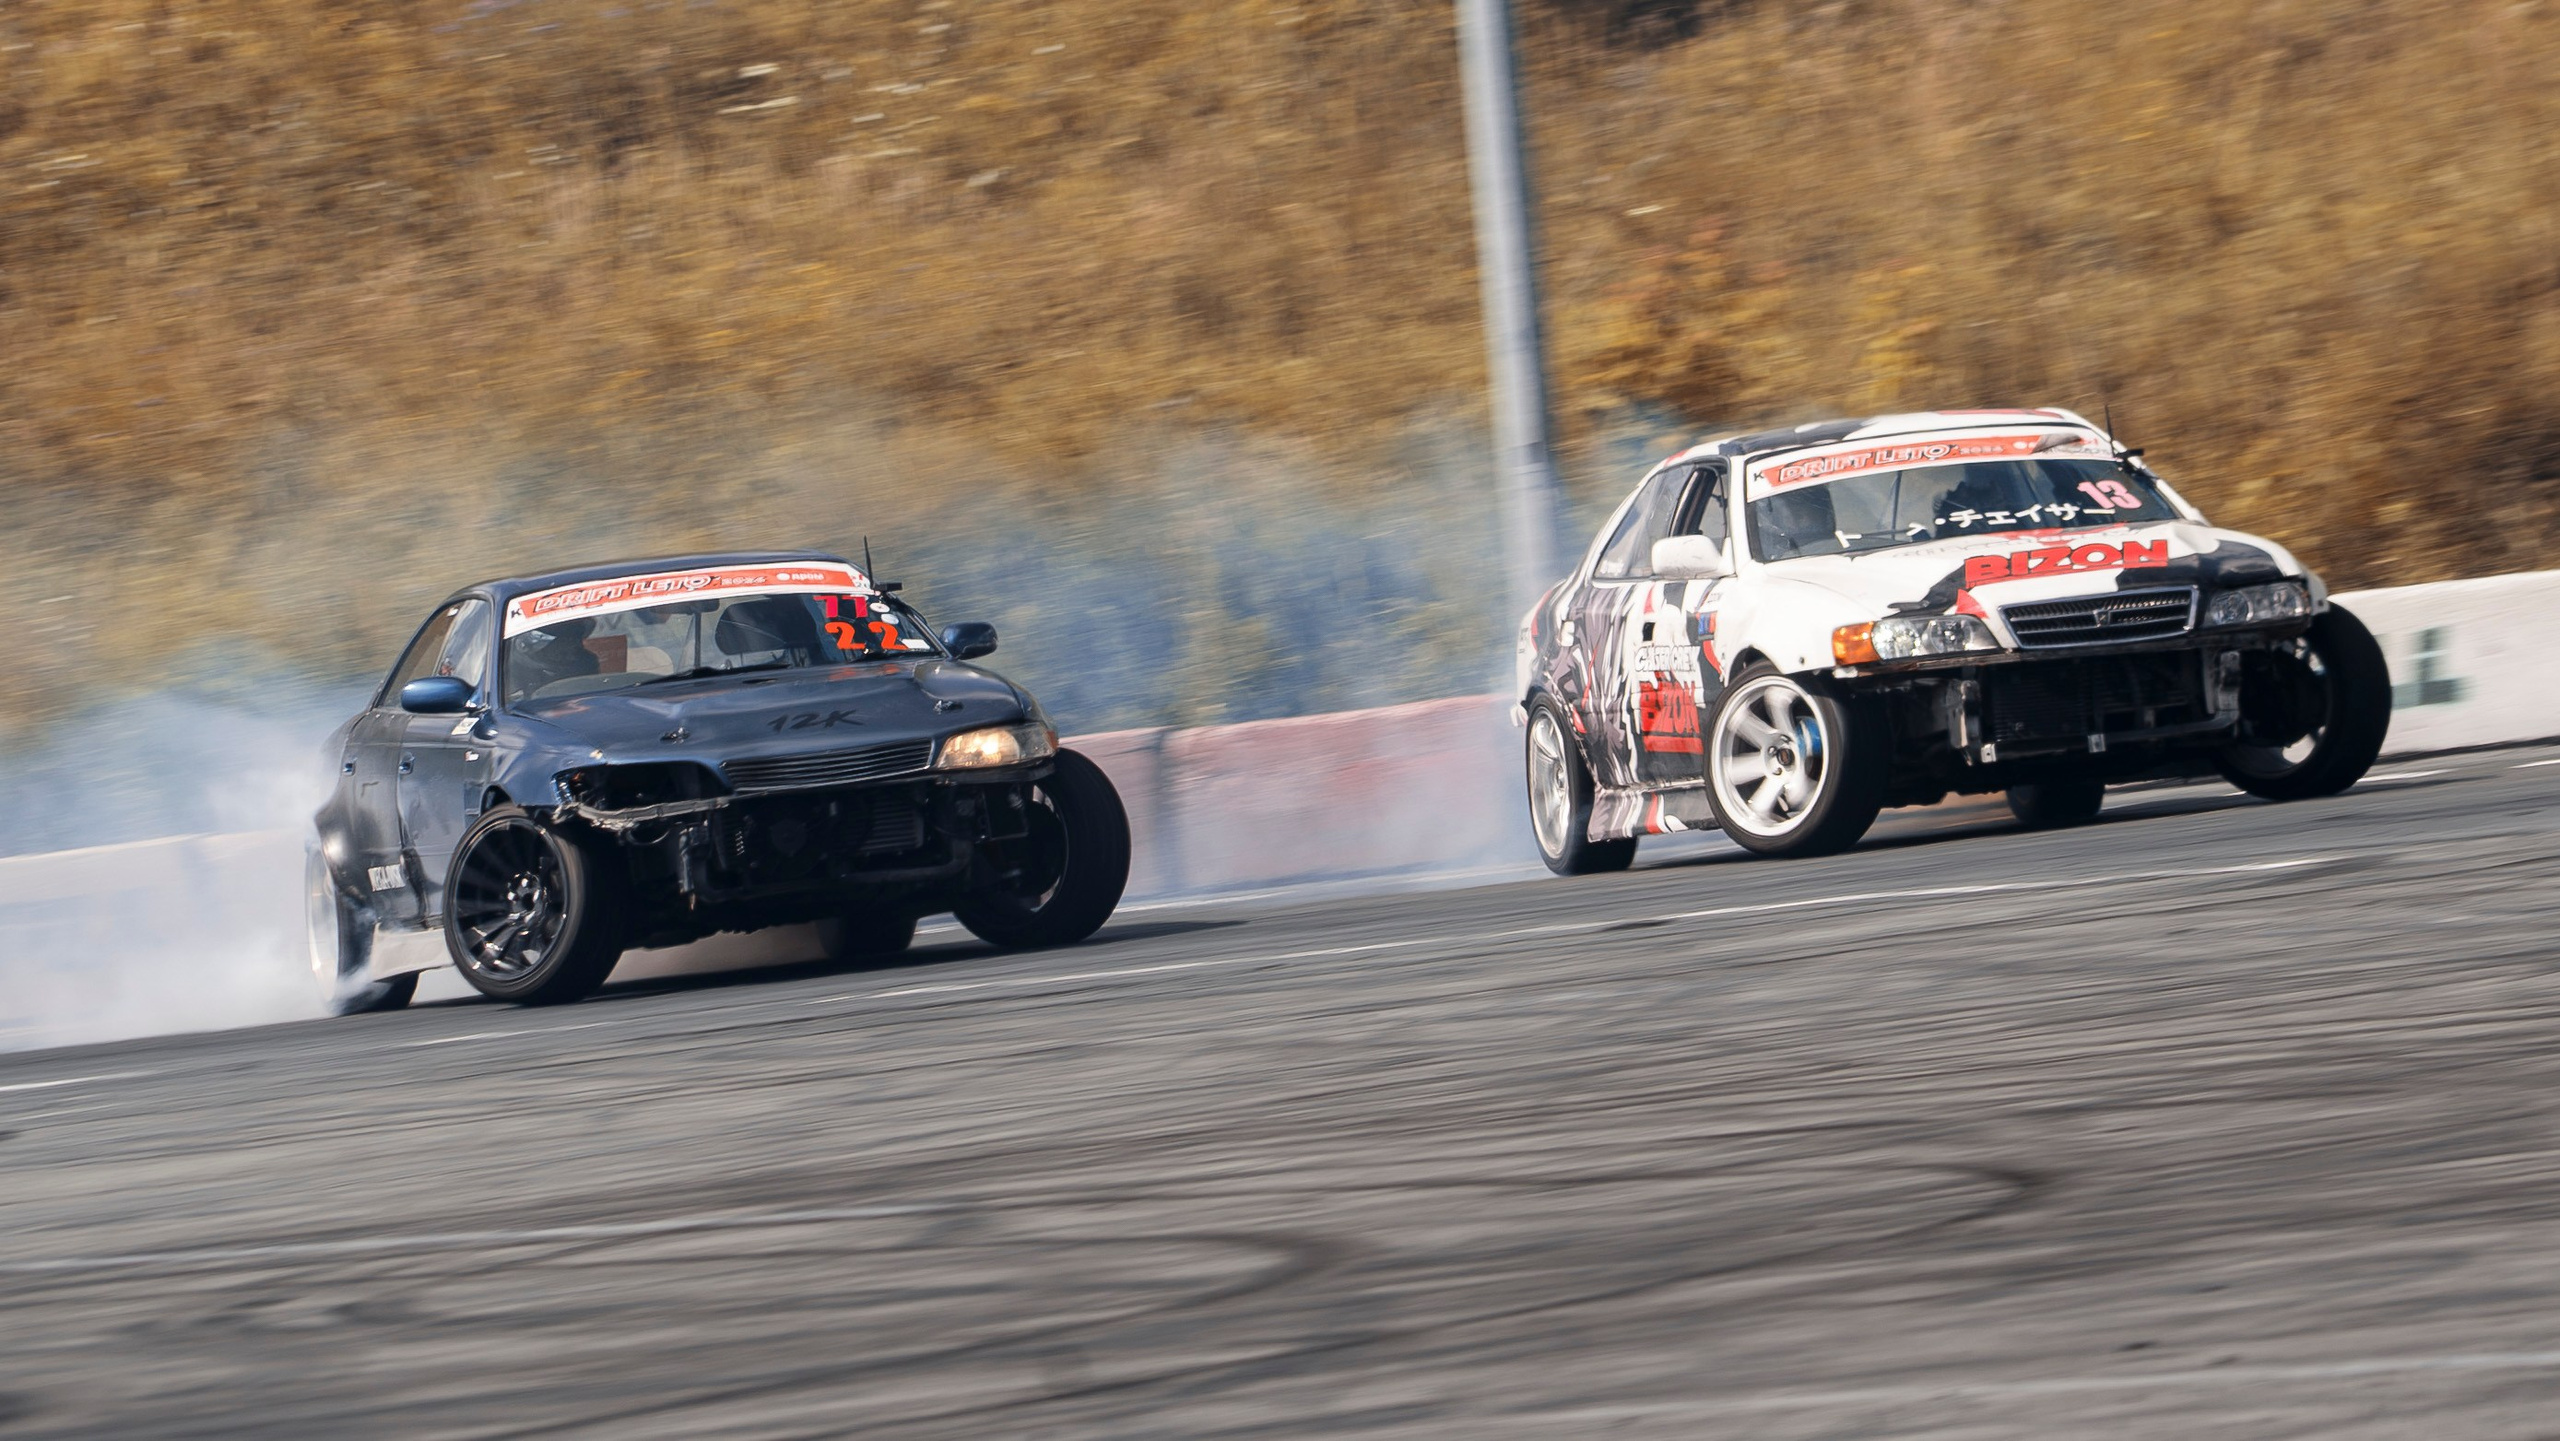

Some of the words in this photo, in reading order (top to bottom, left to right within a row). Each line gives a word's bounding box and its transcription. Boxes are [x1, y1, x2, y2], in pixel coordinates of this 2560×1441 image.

[1779, 453, 1872, 483] DRIFT
[2077, 479, 2142, 510] 13
[1964, 539, 2169, 589] BIZON
[534, 582, 631, 613] DRIFT
[824, 621, 908, 650] 22
[1639, 680, 1700, 734] BIZON
